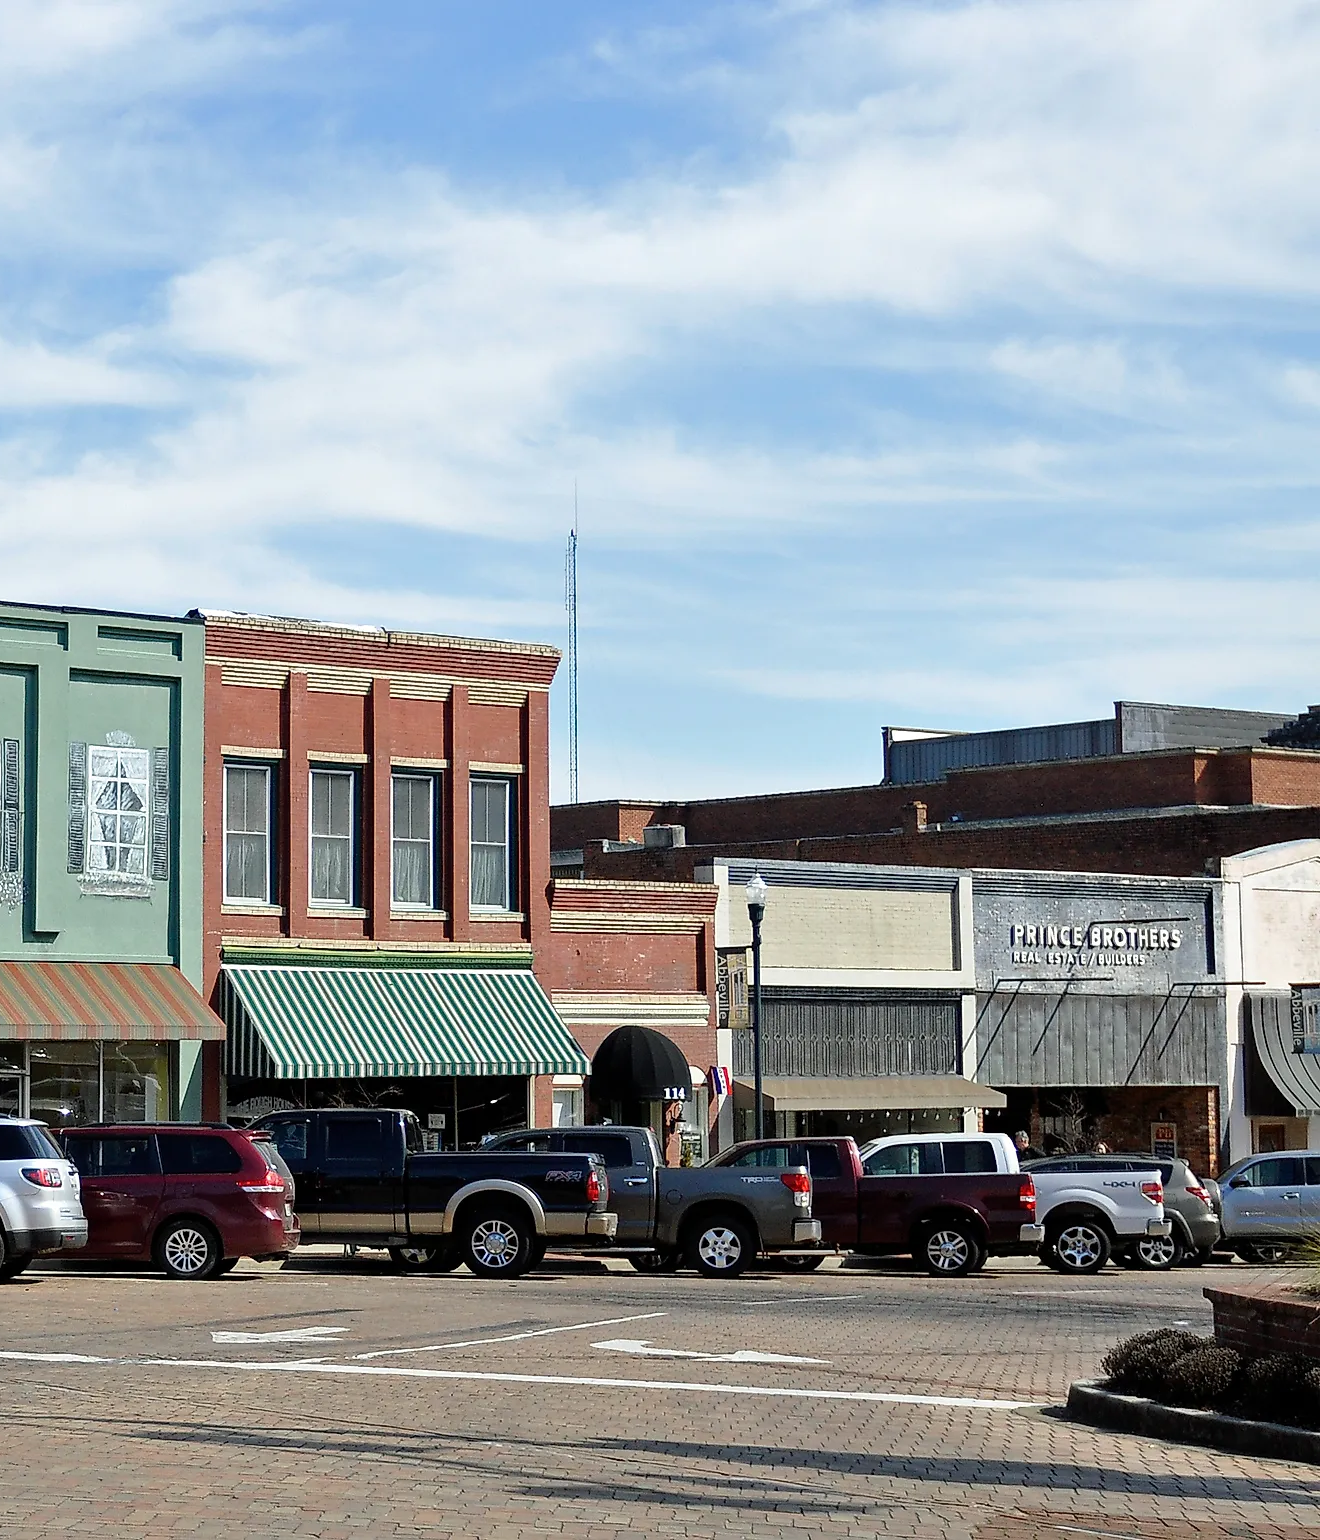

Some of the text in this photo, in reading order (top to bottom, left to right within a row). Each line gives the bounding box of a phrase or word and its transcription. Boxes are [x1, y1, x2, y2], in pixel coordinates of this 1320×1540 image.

[1012, 924, 1182, 950] PRINCE BROTHERS
[1013, 951, 1041, 965] REAL
[717, 955, 730, 1020] Abbeville
[1291, 989, 1305, 1046] Abbeville
[663, 1086, 686, 1100] 114
[740, 1176, 763, 1184] TRD
